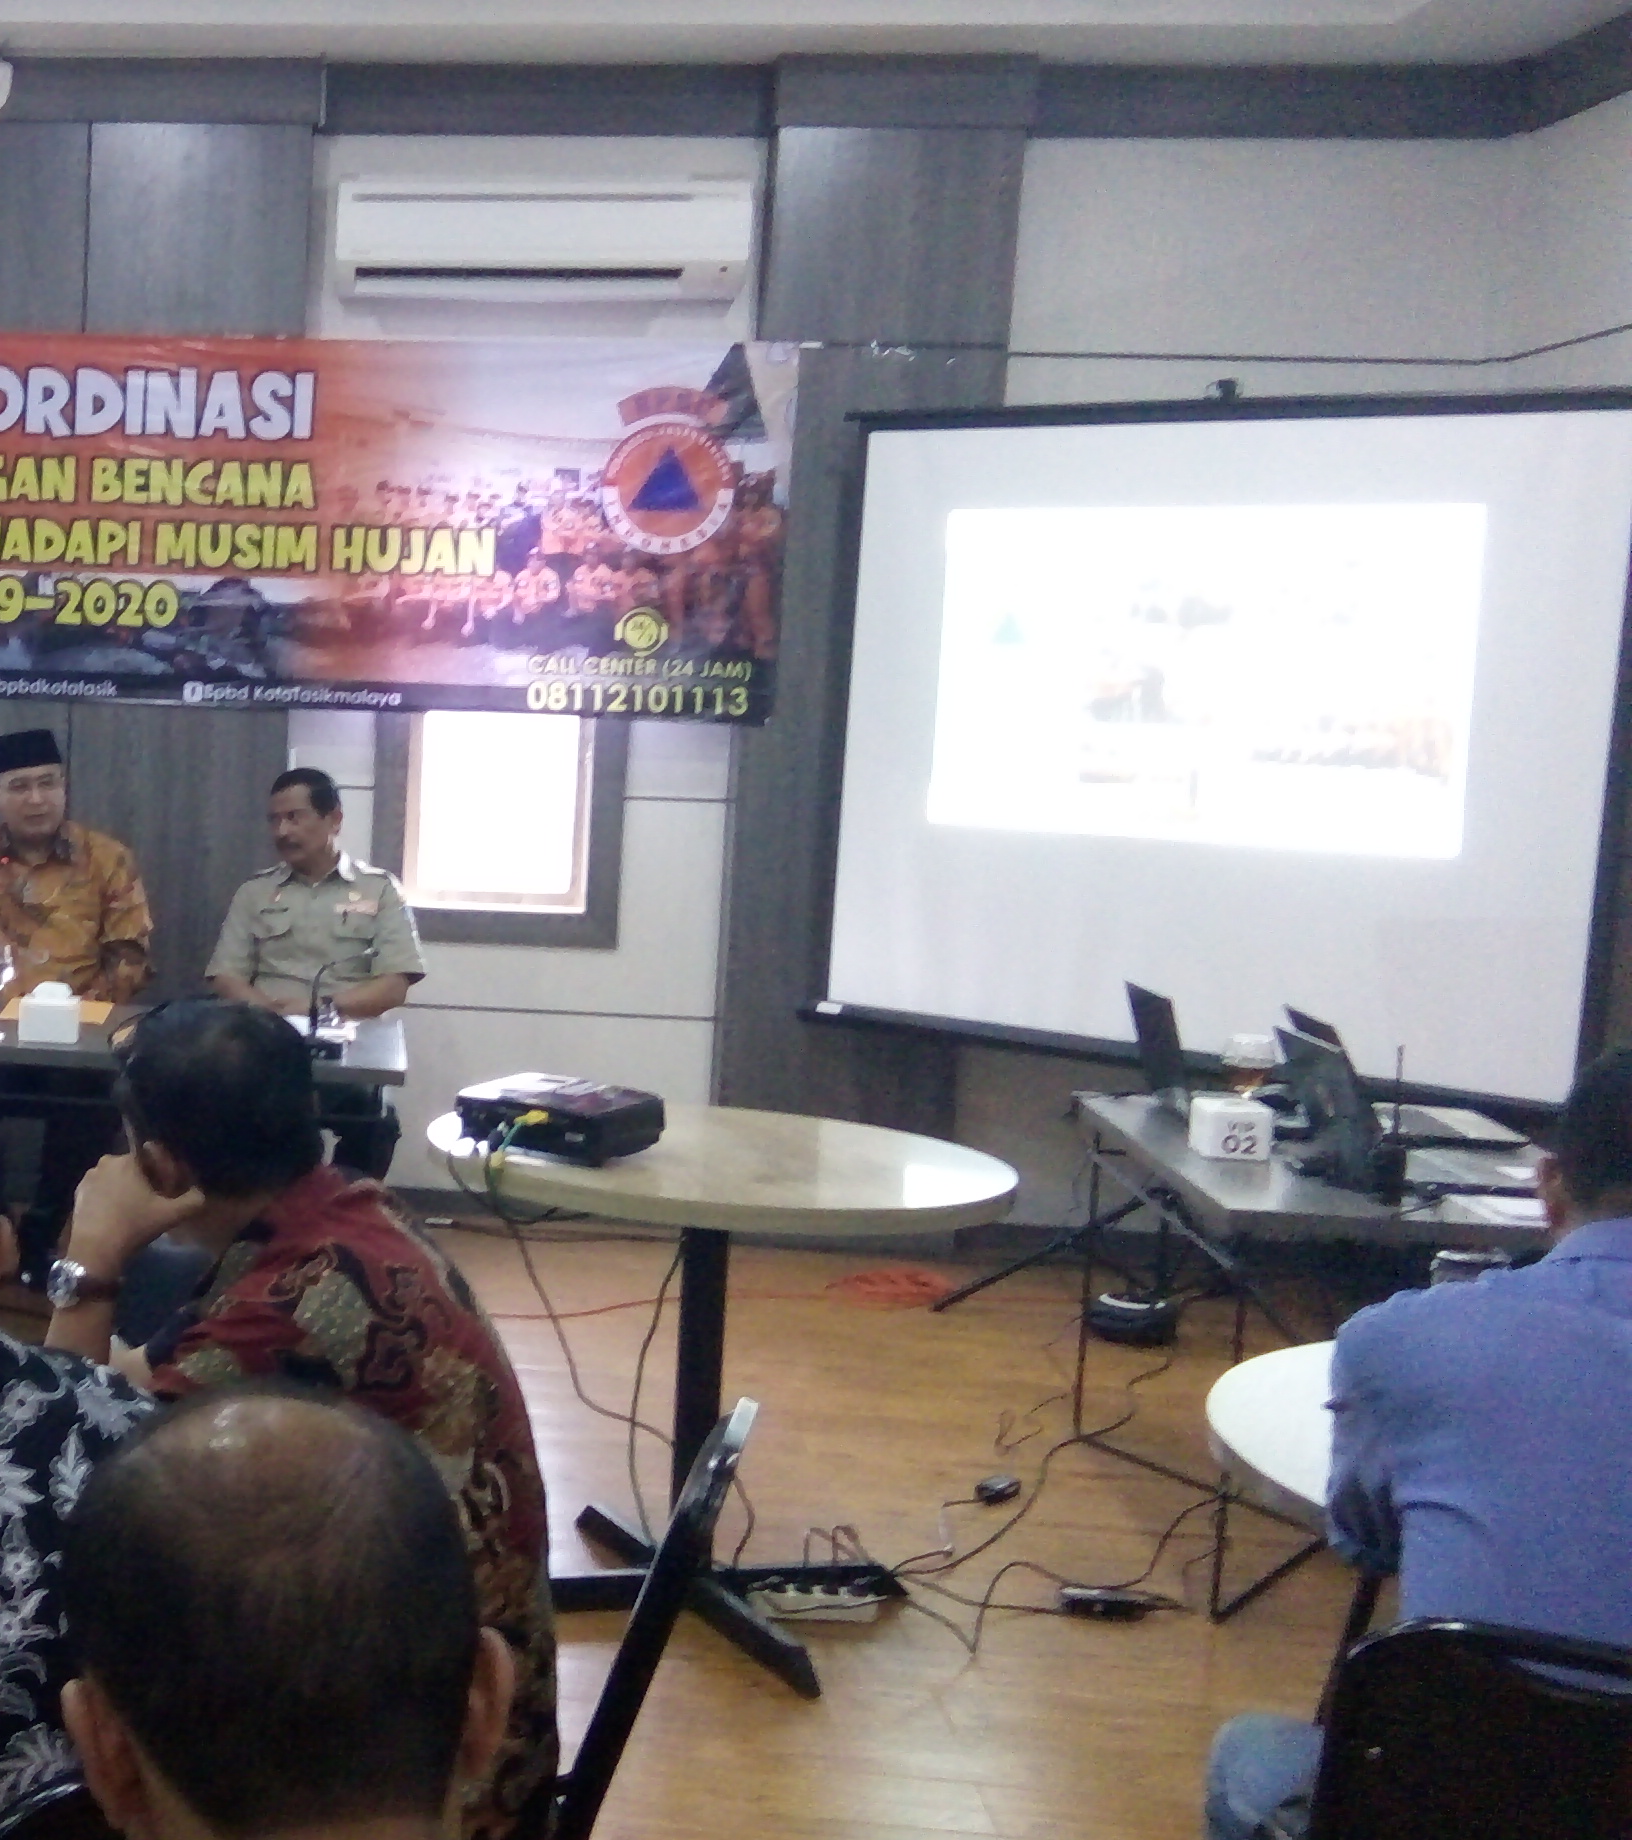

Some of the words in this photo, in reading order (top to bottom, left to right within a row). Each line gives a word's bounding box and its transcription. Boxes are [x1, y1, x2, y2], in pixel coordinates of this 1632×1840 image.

[91, 455, 315, 508] BENCANA
[154, 522, 318, 572] MUSIM
[332, 526, 496, 577] HUJAN
[527, 656, 577, 676] CALL
[584, 655, 659, 677] CENTER
[662, 658, 694, 679] (24
[699, 660, 753, 682] JAM)
[526, 681, 750, 717] 08112101113
[1221, 1134, 1257, 1155] 02
